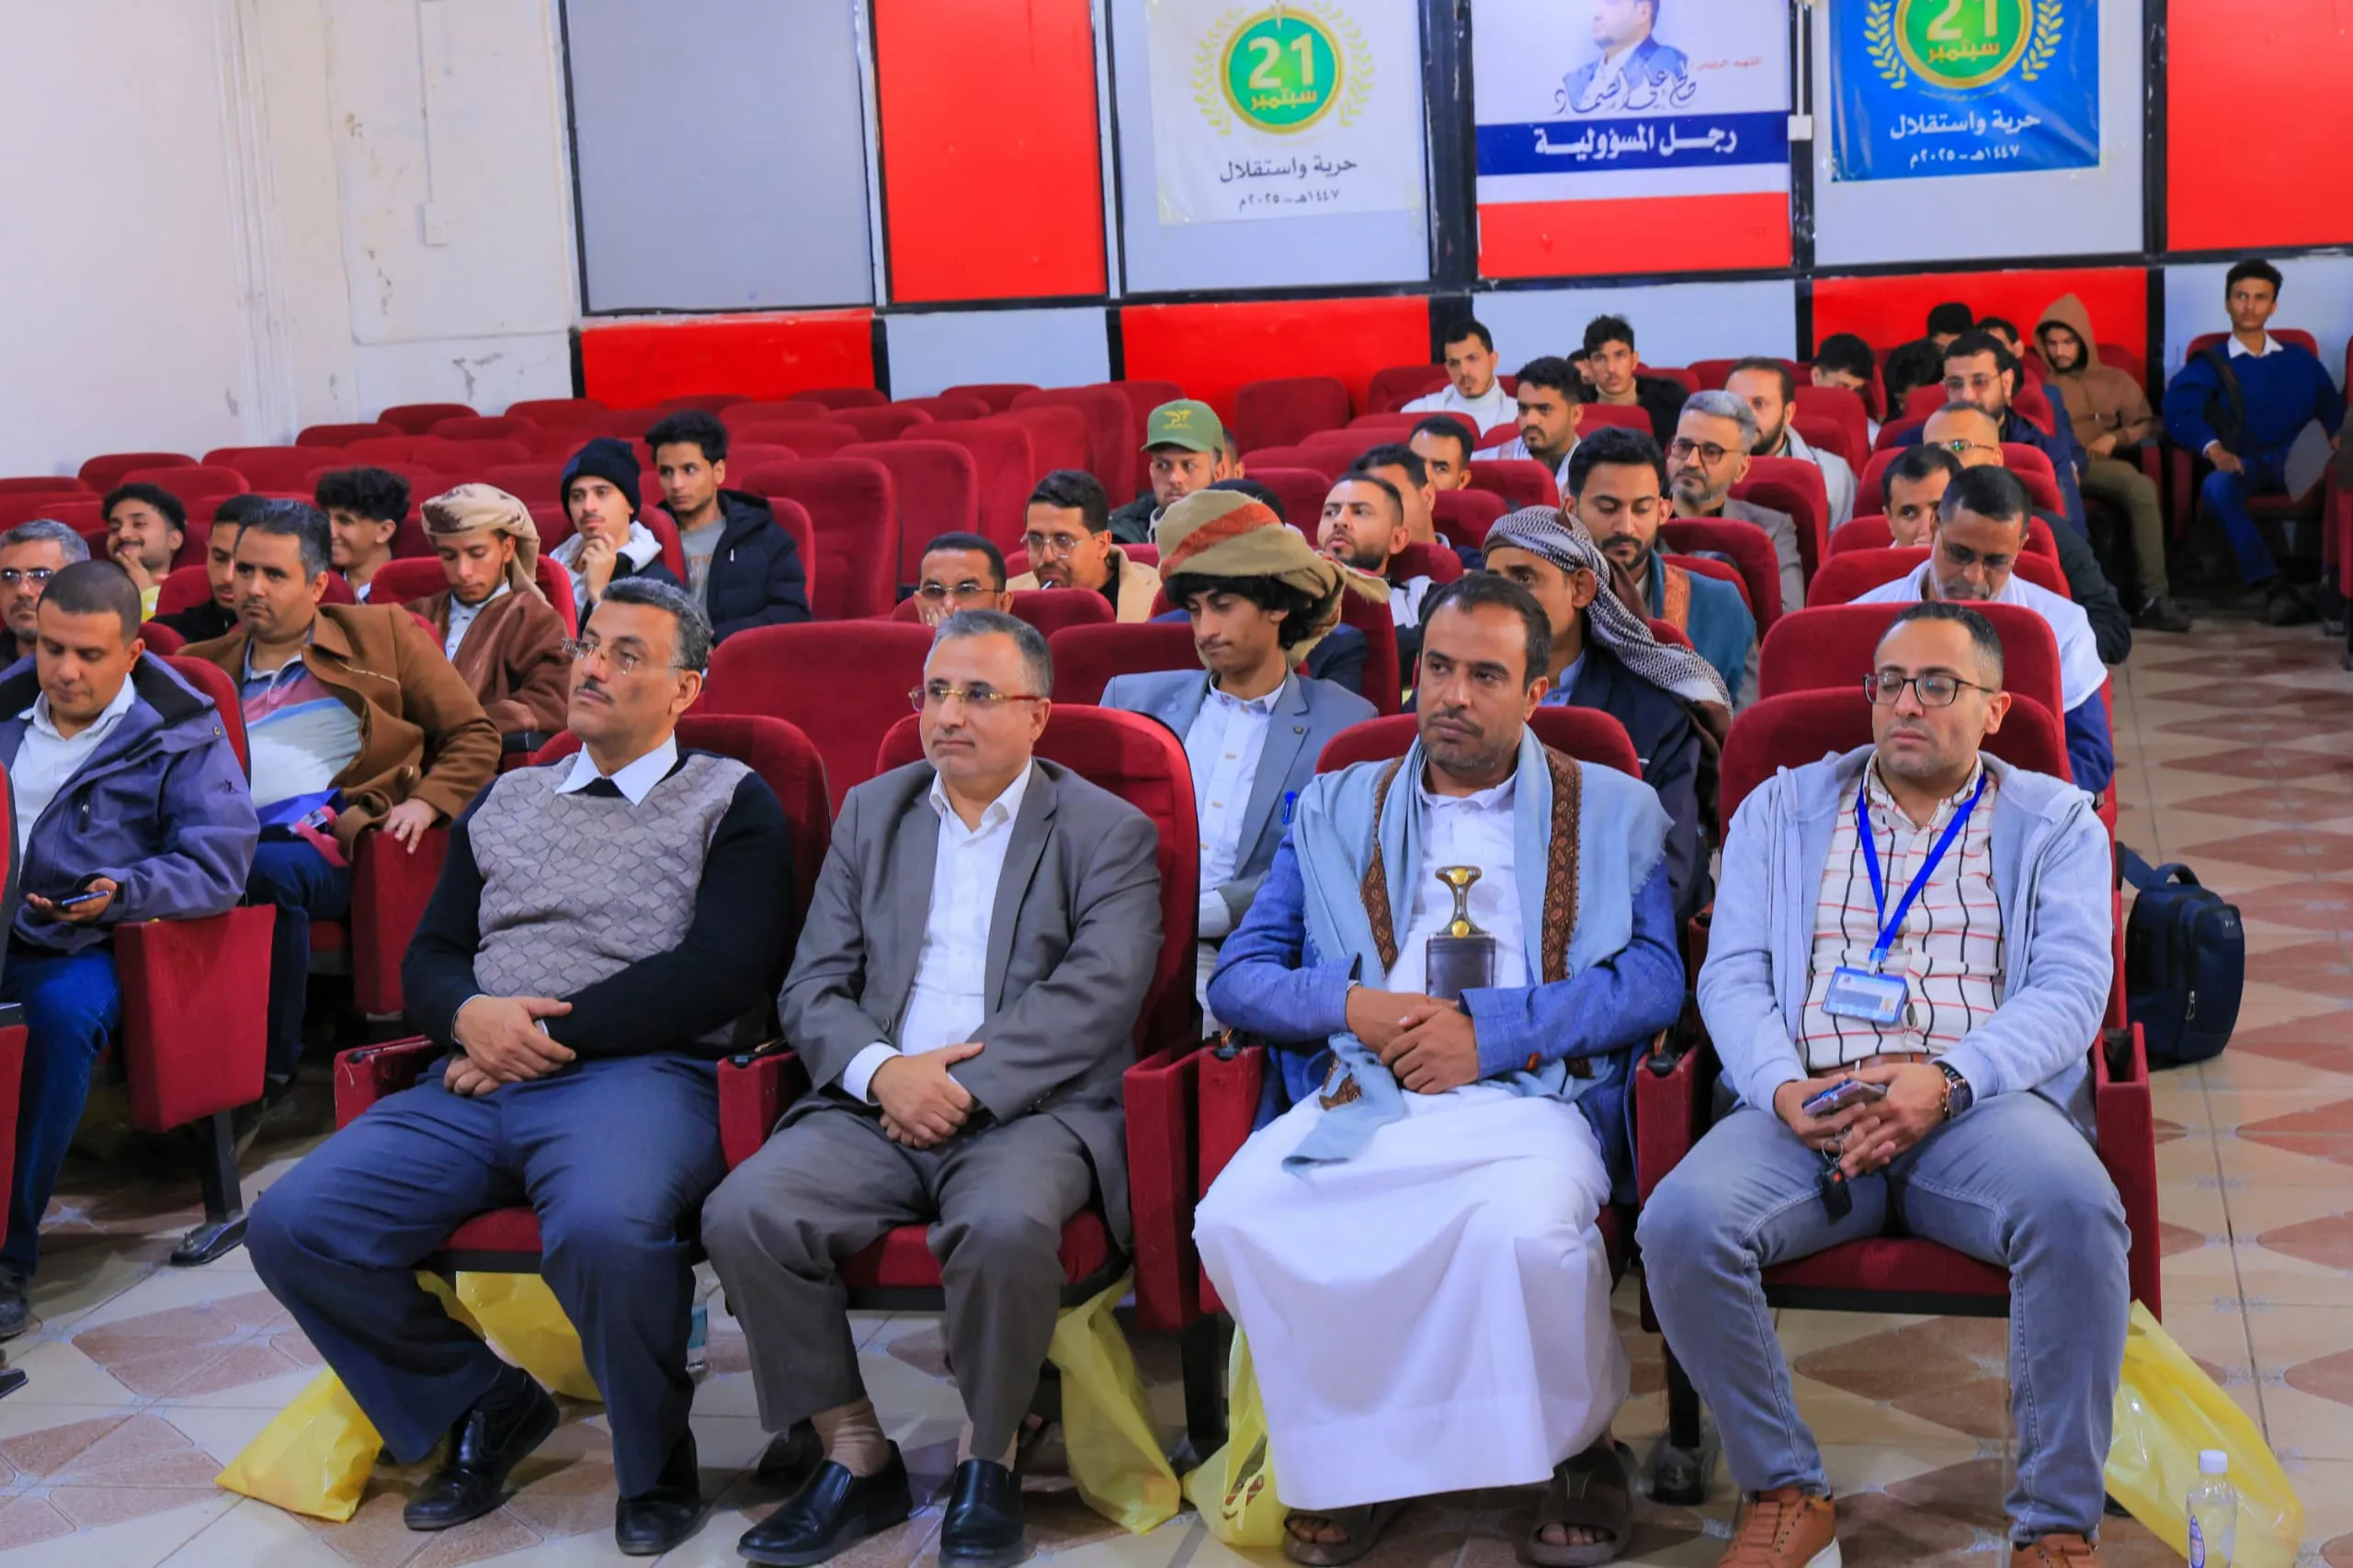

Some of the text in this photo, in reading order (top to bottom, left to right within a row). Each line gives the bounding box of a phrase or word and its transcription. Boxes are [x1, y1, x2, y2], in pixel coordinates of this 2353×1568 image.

[1927, 0, 1998, 41] 21
[1248, 33, 1314, 90] 21
[1927, 40, 2000, 65] سبتمبر
[1250, 87, 1318, 111] سبتمبر
[1659, 121, 1738, 157] رجل
[1890, 108, 2041, 140] حرية واستقلال
[1220, 154, 1358, 183] حرية واستقلال
